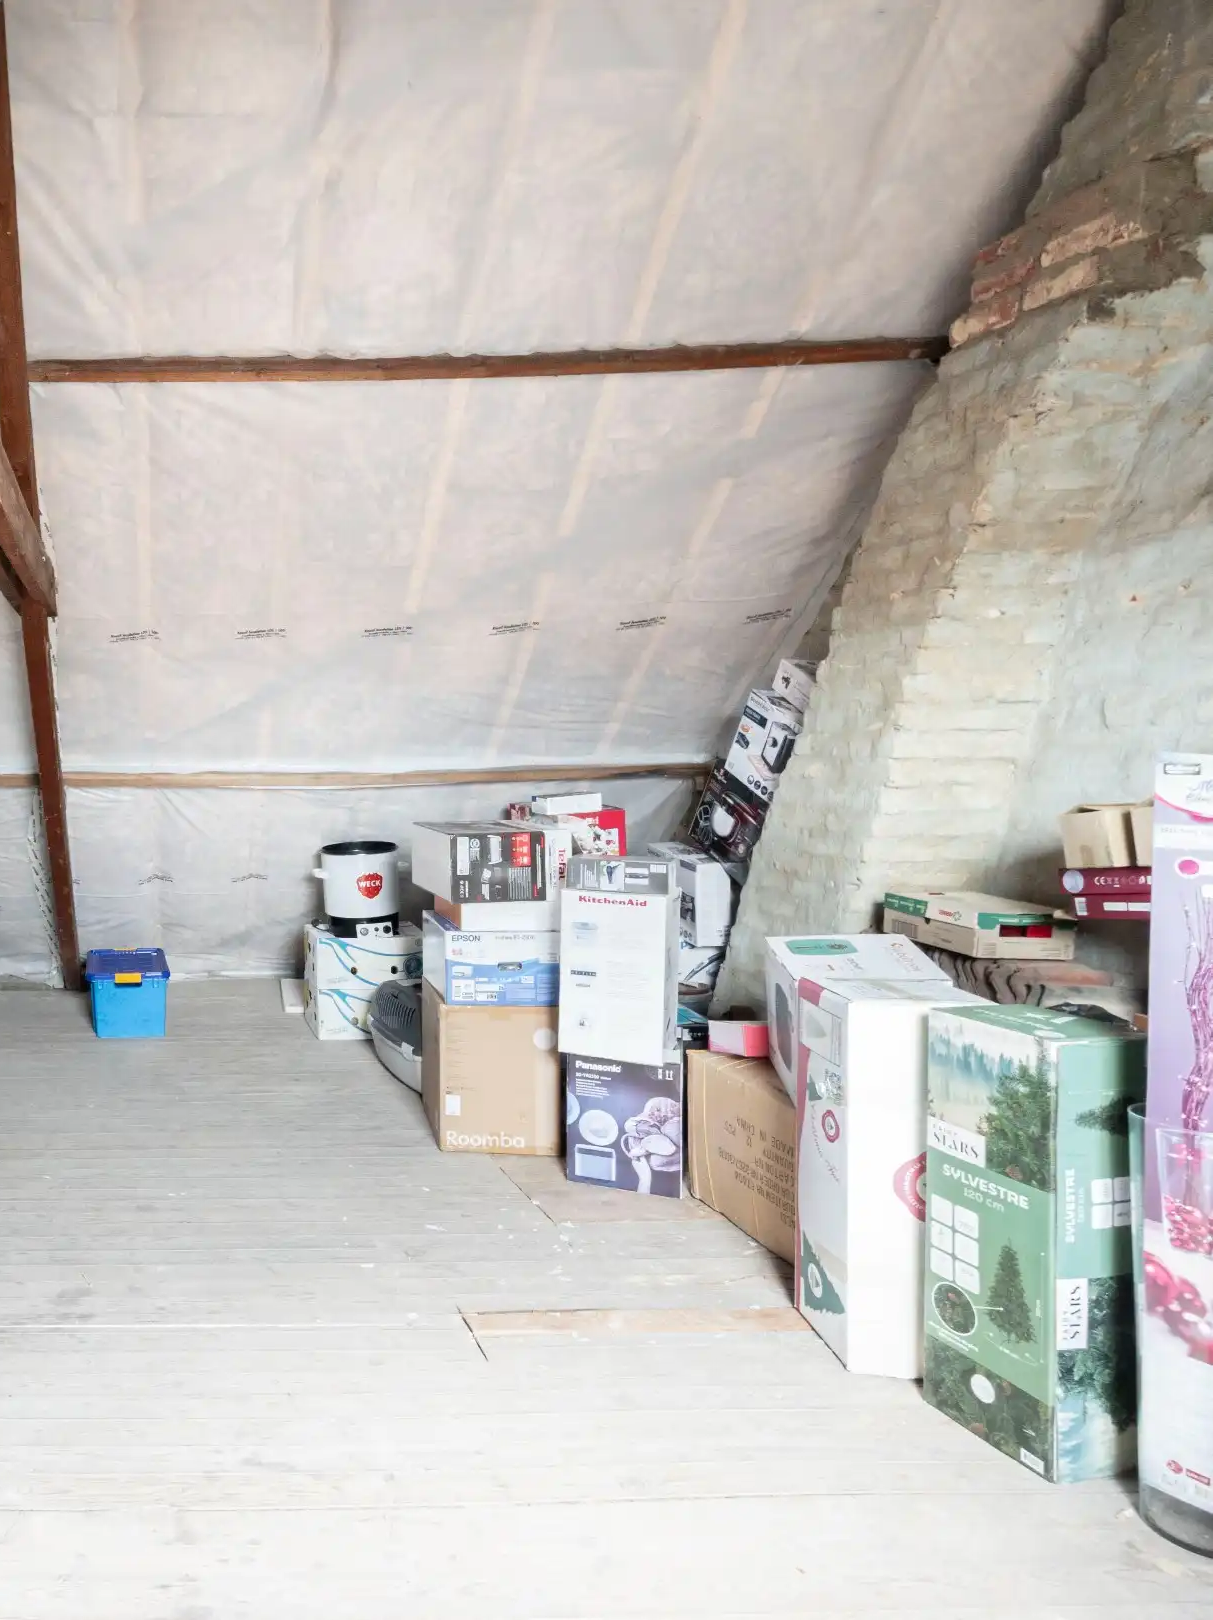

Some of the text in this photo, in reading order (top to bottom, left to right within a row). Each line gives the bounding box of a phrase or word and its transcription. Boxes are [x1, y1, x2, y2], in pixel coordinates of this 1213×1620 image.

[558, 849, 567, 880] Tefal
[357, 880, 381, 888] WECK
[578, 895, 647, 907] KitchenAid
[451, 934, 481, 942] EPSON
[575, 1060, 622, 1073] Panasonic
[446, 1130, 525, 1148] Roomba
[934, 1131, 979, 1159] STARS
[942, 1163, 1030, 1210] SYLVESTRE
[985, 1198, 1005, 1213] cm
[1064, 1168, 1076, 1244] SYLVESTRE
[1070, 1286, 1081, 1340] STARS
